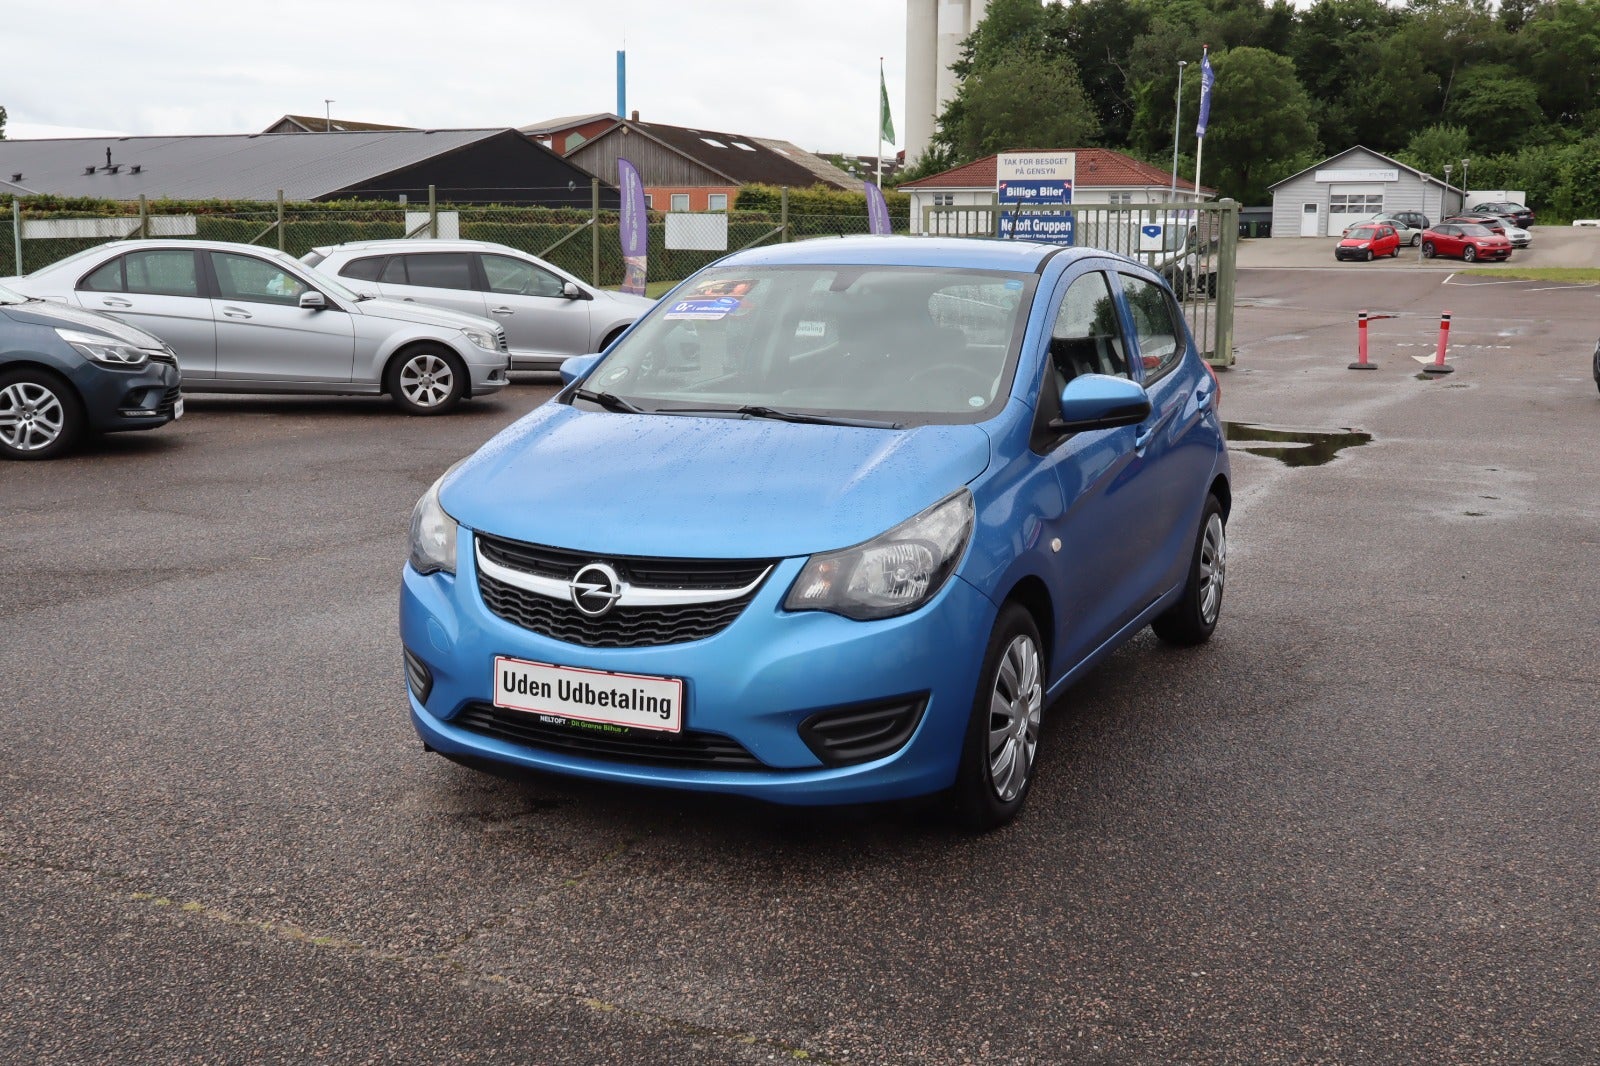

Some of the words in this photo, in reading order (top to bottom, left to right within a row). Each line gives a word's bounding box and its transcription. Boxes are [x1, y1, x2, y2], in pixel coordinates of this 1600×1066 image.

[1004, 158, 1017, 166] TAK
[1036, 157, 1068, 165] BESØGET
[1015, 167, 1024, 175] PÅ
[1006, 186, 1037, 198] Billige
[1039, 187, 1064, 196] Biler
[1001, 218, 1031, 232] Netoft
[1033, 219, 1072, 233] Gruppen
[503, 670, 551, 698] Uden
[558, 679, 672, 720] Udbetaling
[539, 715, 566, 725] NELTOFT
[571, 719, 580, 727] Dit
[603, 724, 622, 733] Bilhus
